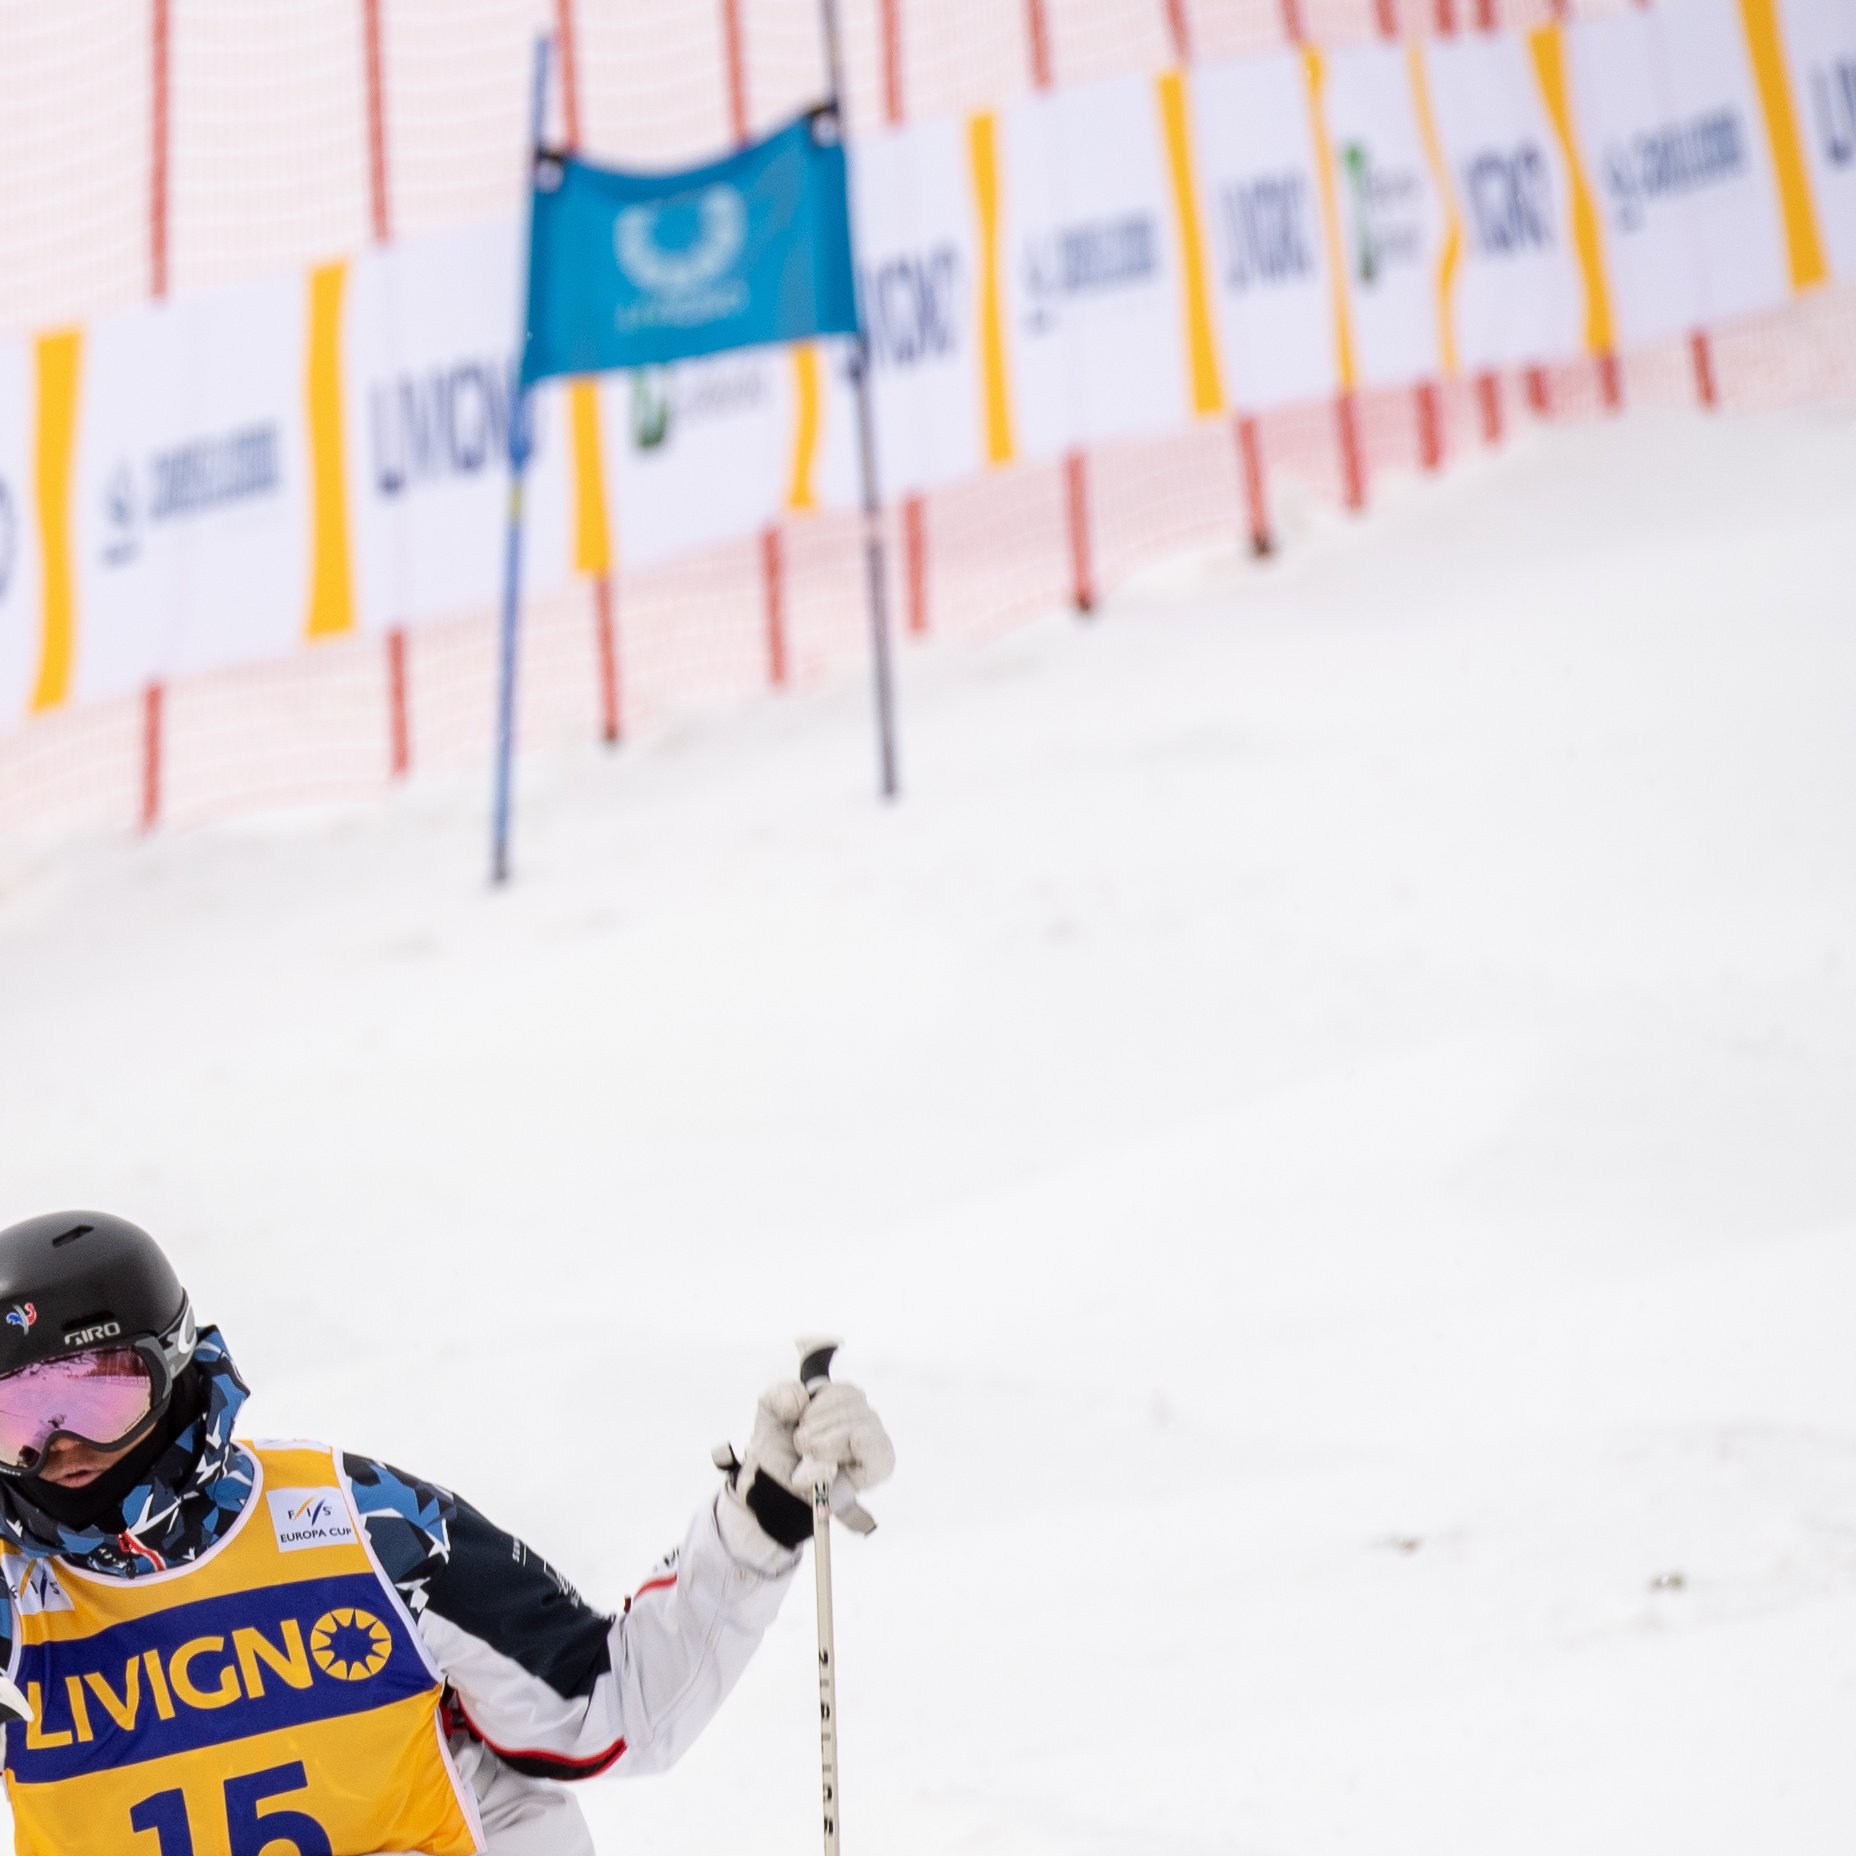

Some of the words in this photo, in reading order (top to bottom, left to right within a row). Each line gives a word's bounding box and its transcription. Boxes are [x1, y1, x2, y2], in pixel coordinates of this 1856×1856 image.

[63, 1320, 121, 1347] GIRO
[279, 1529, 327, 1543] EUROPA
[26, 1606, 393, 1750] LIVIGNO
